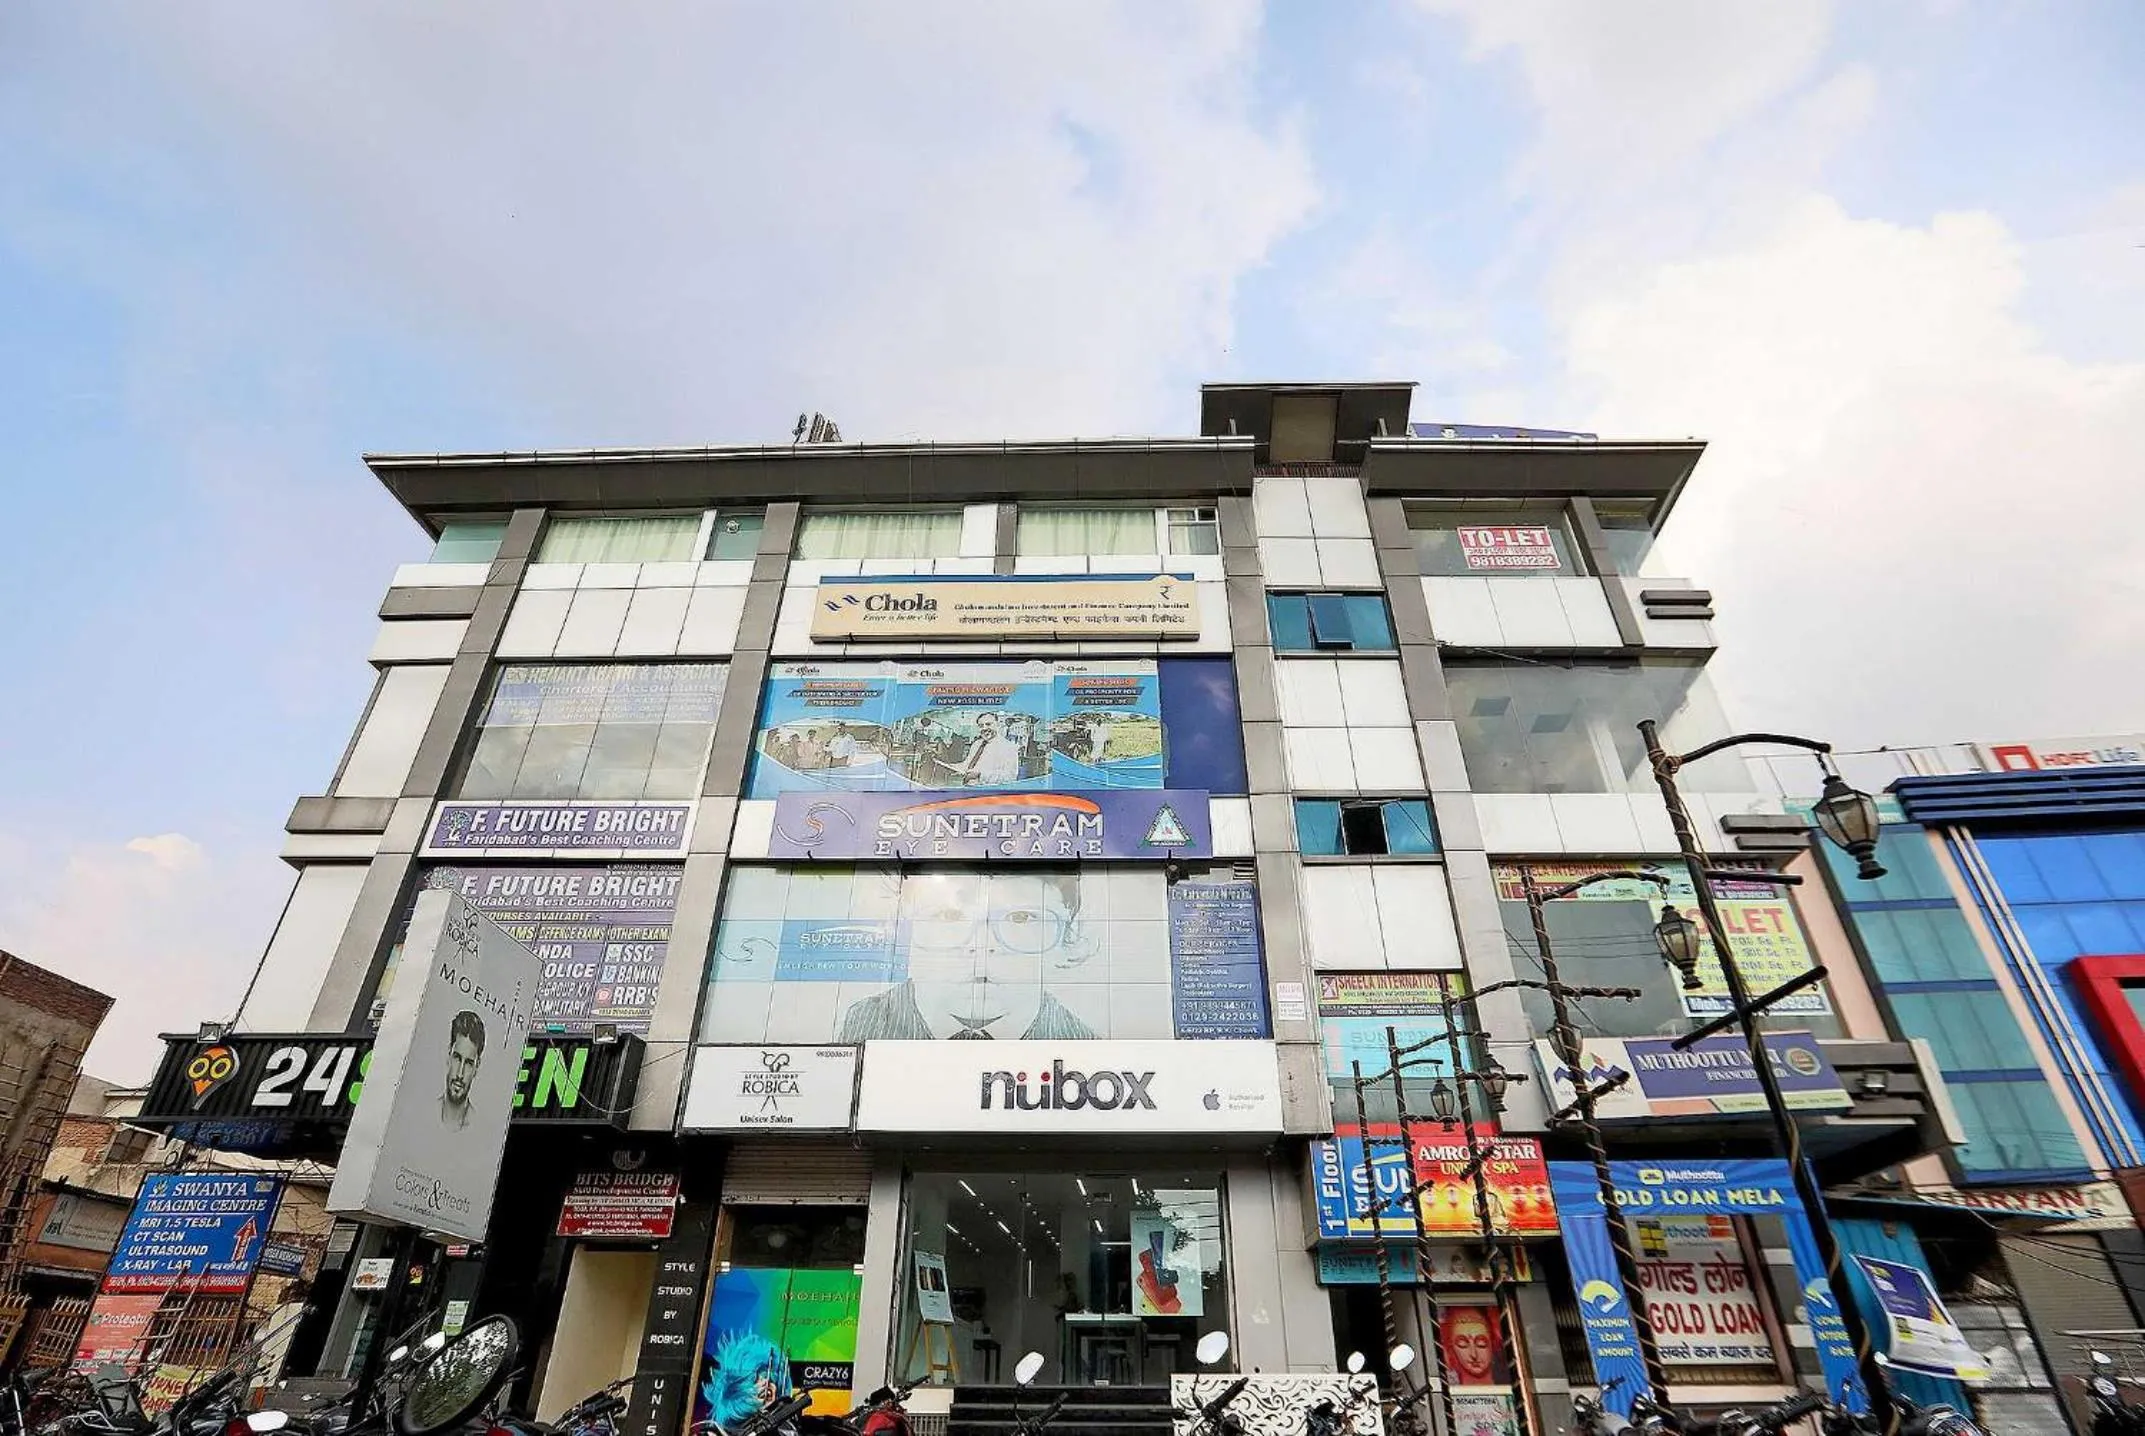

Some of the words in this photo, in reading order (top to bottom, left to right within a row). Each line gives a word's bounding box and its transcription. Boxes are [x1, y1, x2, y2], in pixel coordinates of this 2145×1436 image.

[1462, 530, 1547, 547] TO-LET
[865, 593, 938, 612] Chola
[920, 670, 944, 678] Chola
[470, 810, 487, 832] F.
[494, 810, 586, 832] FUTURE
[594, 810, 685, 832] BRIGHT
[877, 813, 1105, 840] SUNETRAM
[464, 834, 537, 846] Faridabad's
[541, 834, 569, 846] Best
[572, 834, 630, 847] Coaching
[635, 834, 676, 846] Centre
[874, 840, 949, 856] EYE
[1000, 840, 1103, 856] CARE
[461, 876, 477, 895] F.
[487, 876, 580, 895] FUTURE
[588, 875, 680, 895] BRIGHT
[535, 896, 565, 907] Best
[567, 896, 626, 909] Coaching
[631, 896, 674, 907] Centre
[534, 911, 592, 921] AVAILABLE
[1722, 908, 1785, 933] LET
[540, 944, 573, 959] NDA
[623, 946, 654, 963] SSC
[544, 963, 596, 979] OLICE
[618, 966, 664, 984] BANKIN
[742, 1080, 800, 1094] ROBICA
[740, 1115, 768, 1124] Unisex
[770, 1115, 793, 1124] Salon
[1490, 1144, 1538, 1161] STAR
[1322, 1141, 1342, 1198] Floor
[1493, 1161, 1520, 1175] SPA
[577, 1172, 612, 1186] BITS
[613, 1172, 675, 1187] BRIDGE
[172, 1182, 249, 1197] SWANYA
[428, 1179, 441, 1211] &
[1660, 1189, 1721, 1206] LOAN
[1727, 1188, 1785, 1205] MELA
[144, 1199, 208, 1212] IMAGING
[209, 1199, 268, 1212] CENTRE
[138, 1217, 161, 1228] MRI
[163, 1217, 181, 1228] 1.5
[185, 1217, 222, 1228] TESLA
[134, 1231, 150, 1242] CT
[151, 1231, 185, 1242] SCAN
[128, 1245, 209, 1256] ULTRASOUND
[120, 1259, 158, 1271] X-RAY
[664, 1262, 696, 1272] STYLE
[1636, 1258, 1699, 1295] गोल्ड
[657, 1286, 693, 1296] STUDIO
[663, 1310, 677, 1320] BY
[1649, 1302, 1705, 1334] GOLD
[1708, 1302, 1766, 1334] LOAN
[650, 1334, 685, 1345] ROBICA
[1600, 1332, 1626, 1343] LOAN
[1597, 1346, 1634, 1357] AMOUNT
[804, 1366, 849, 1380] CRAZY6
